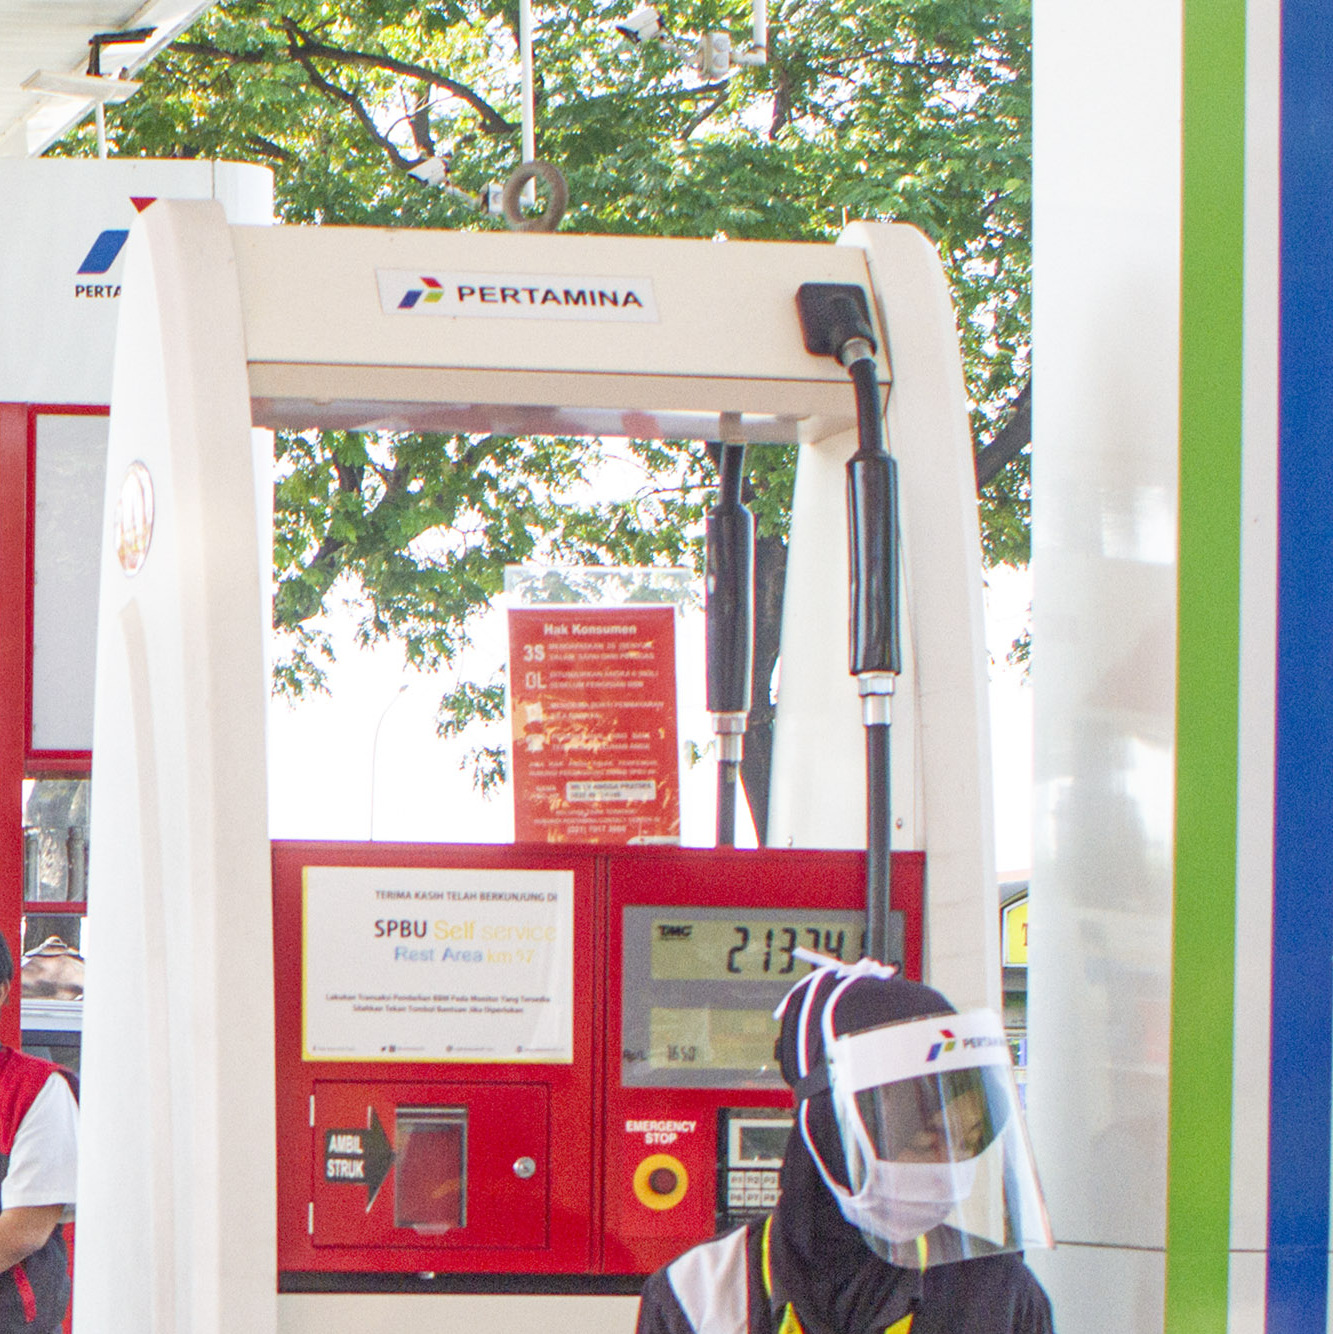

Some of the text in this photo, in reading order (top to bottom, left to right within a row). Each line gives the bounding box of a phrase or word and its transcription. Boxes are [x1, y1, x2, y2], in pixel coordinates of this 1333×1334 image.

[457, 286, 644, 308] PERTAMINA
[544, 623, 637, 635] Hak Konsumen
[523, 644, 545, 662] 3S
[375, 890, 558, 902] TERIMA KASIH TELAH BERKUNJUNG DI
[374, 919, 557, 942] SPBU Self service
[394, 946, 435, 962] Rest
[442, 947, 483, 962] Area
[625, 1120, 697, 1133] EMERGENCY
[328, 1135, 364, 1155] AMBIL
[644, 1132, 678, 1145] STOP
[326, 1158, 365, 1178] STRUK
